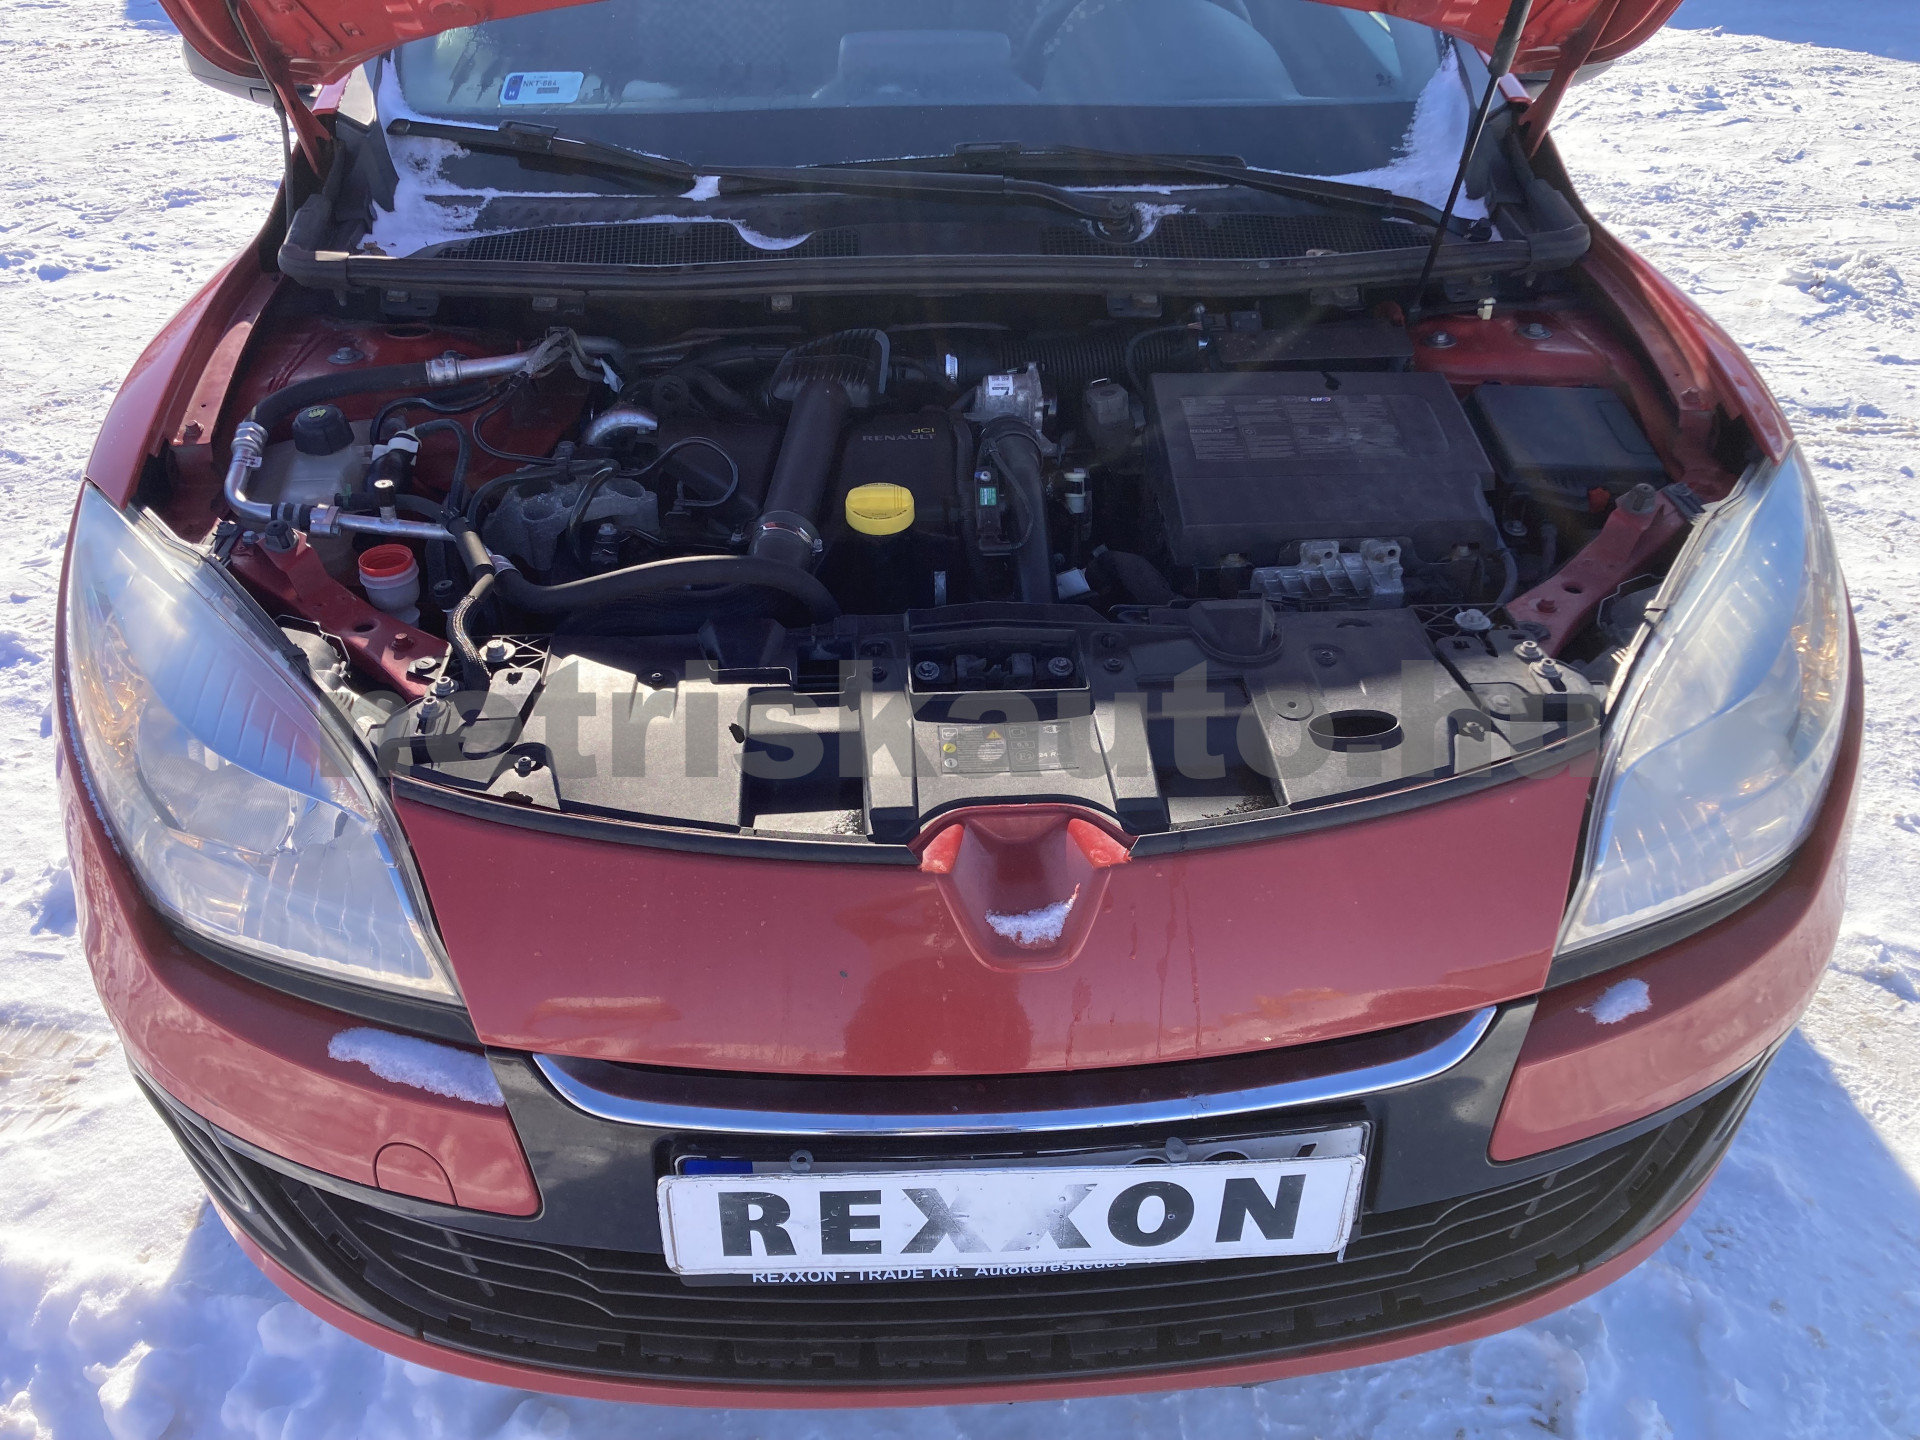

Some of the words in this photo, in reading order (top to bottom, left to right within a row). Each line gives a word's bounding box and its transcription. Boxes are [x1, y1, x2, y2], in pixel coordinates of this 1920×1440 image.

[862, 433, 936, 441] RENAULT
[717, 1174, 1307, 1257] REXXON
[752, 1271, 837, 1283] REXXON
[858, 1268, 924, 1281] TRADE
[931, 1266, 963, 1279] Kft.
